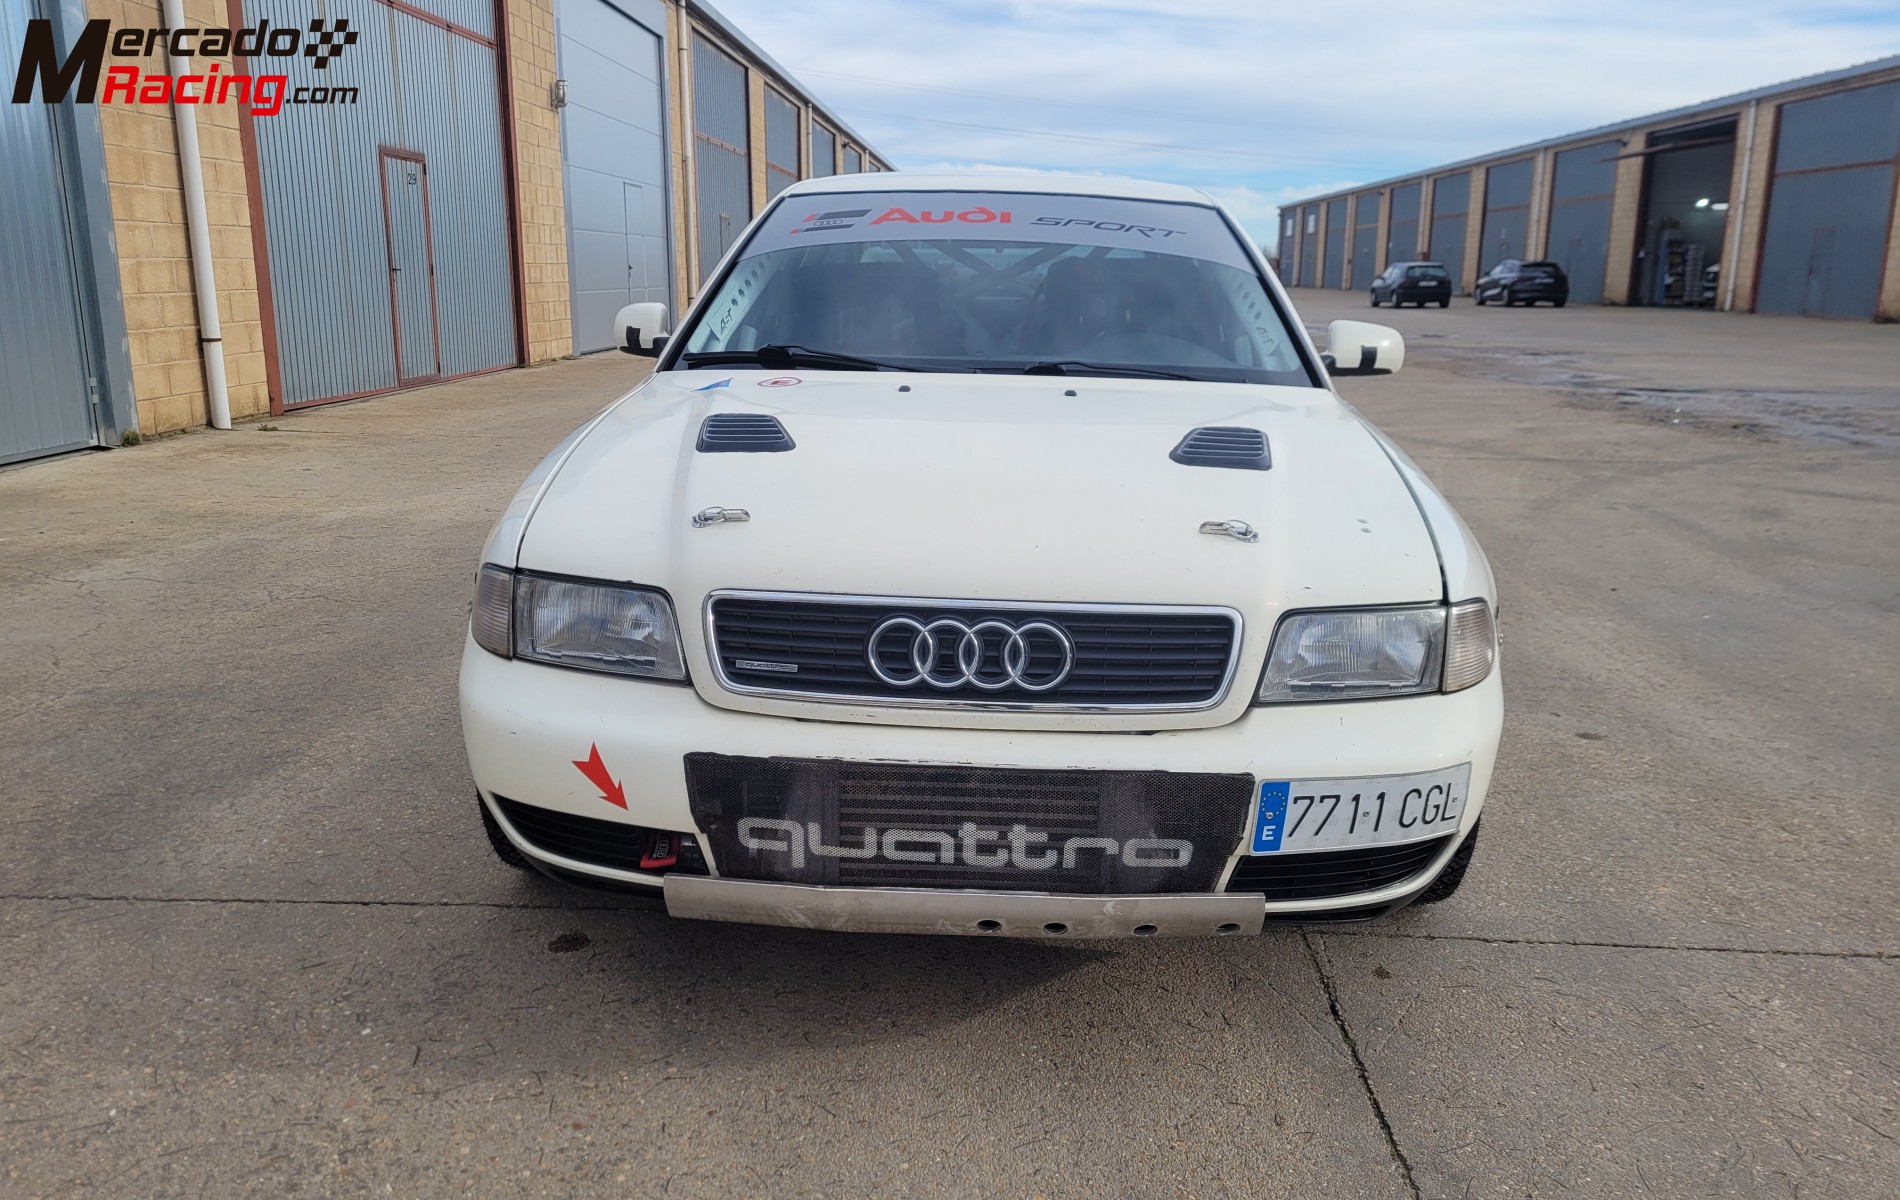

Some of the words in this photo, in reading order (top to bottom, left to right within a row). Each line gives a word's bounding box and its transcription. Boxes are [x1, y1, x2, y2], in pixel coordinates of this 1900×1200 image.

[1030, 217, 1188, 238] SPORT
[745, 662, 788, 670] quattro
[1287, 791, 1386, 838] 7711
[1399, 783, 1457, 829] CGL
[737, 817, 1194, 869] quattro
[1261, 825, 1276, 841] E
